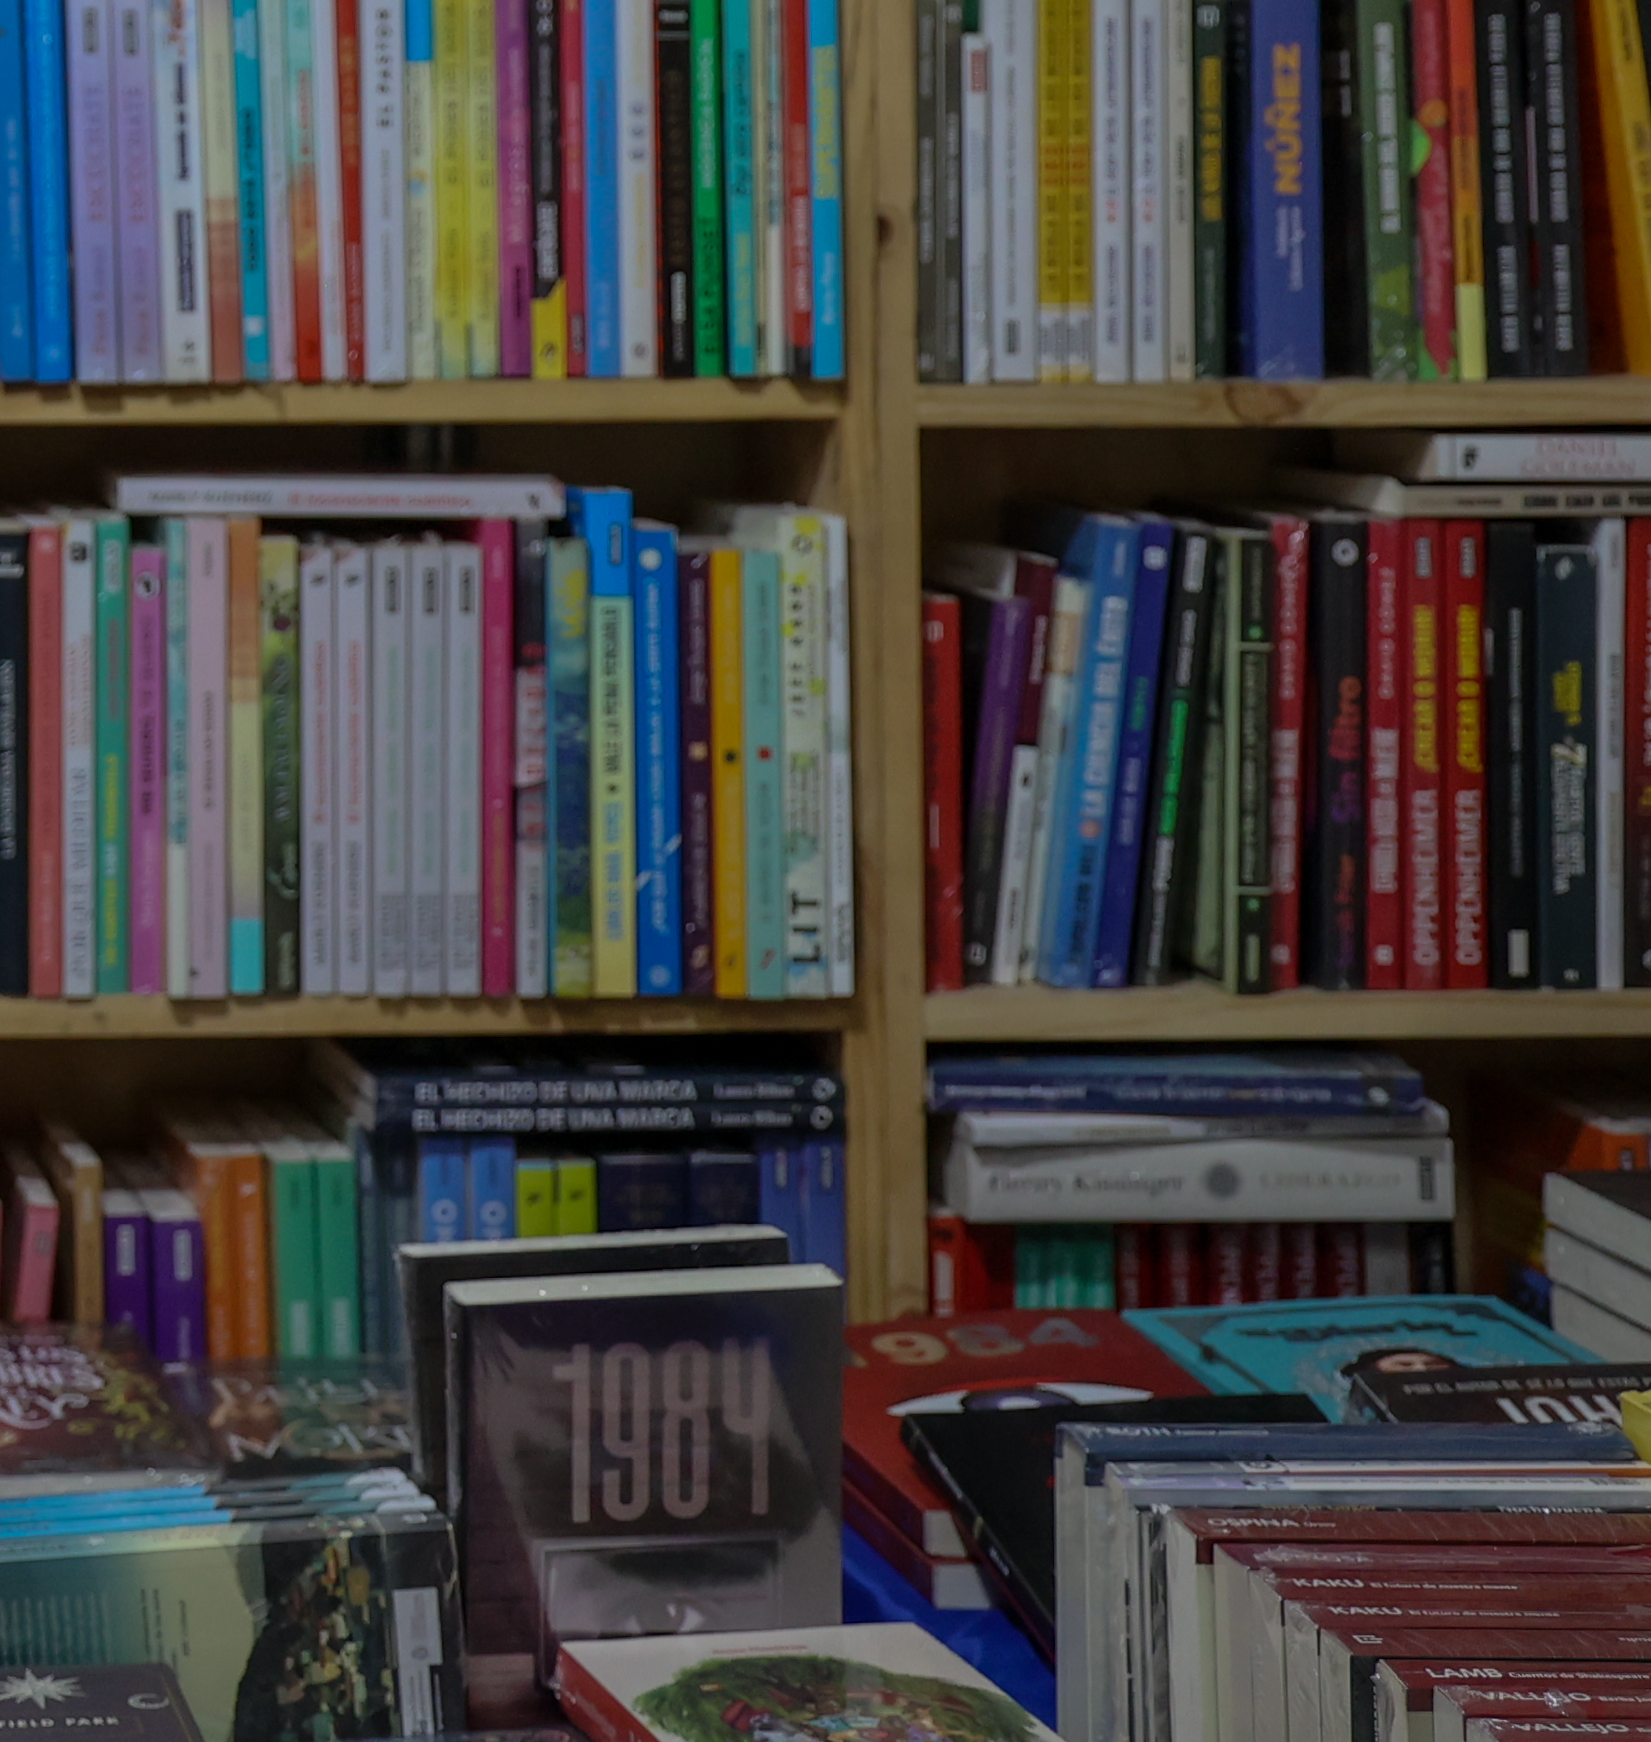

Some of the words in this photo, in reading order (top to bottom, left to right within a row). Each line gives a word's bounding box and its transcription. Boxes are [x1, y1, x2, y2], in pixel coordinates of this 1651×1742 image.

[1263, 42, 1302, 196] NÚÑEZ
[1412, 788, 1439, 966] OPPENHEIMER
[1455, 788, 1482, 966] OPPENHEIMER
[791, 890, 823, 965] LIT
[550, 1336, 772, 1524] 1984
[1207, 1516, 1299, 1528] OSPINA
[1291, 1576, 1366, 1589] KAKU
[1328, 1604, 1404, 1617] KAKU
[1424, 1666, 1504, 1680] LAMB
[1508, 1670, 1558, 1680] Cuentos
[1559, 1671, 1574, 1680] de
[1574, 1671, 1651, 1682] Shakespeare
[64, 1714, 121, 1727] PARK
[1513, 1721, 1630, 1734] VALLEJO
